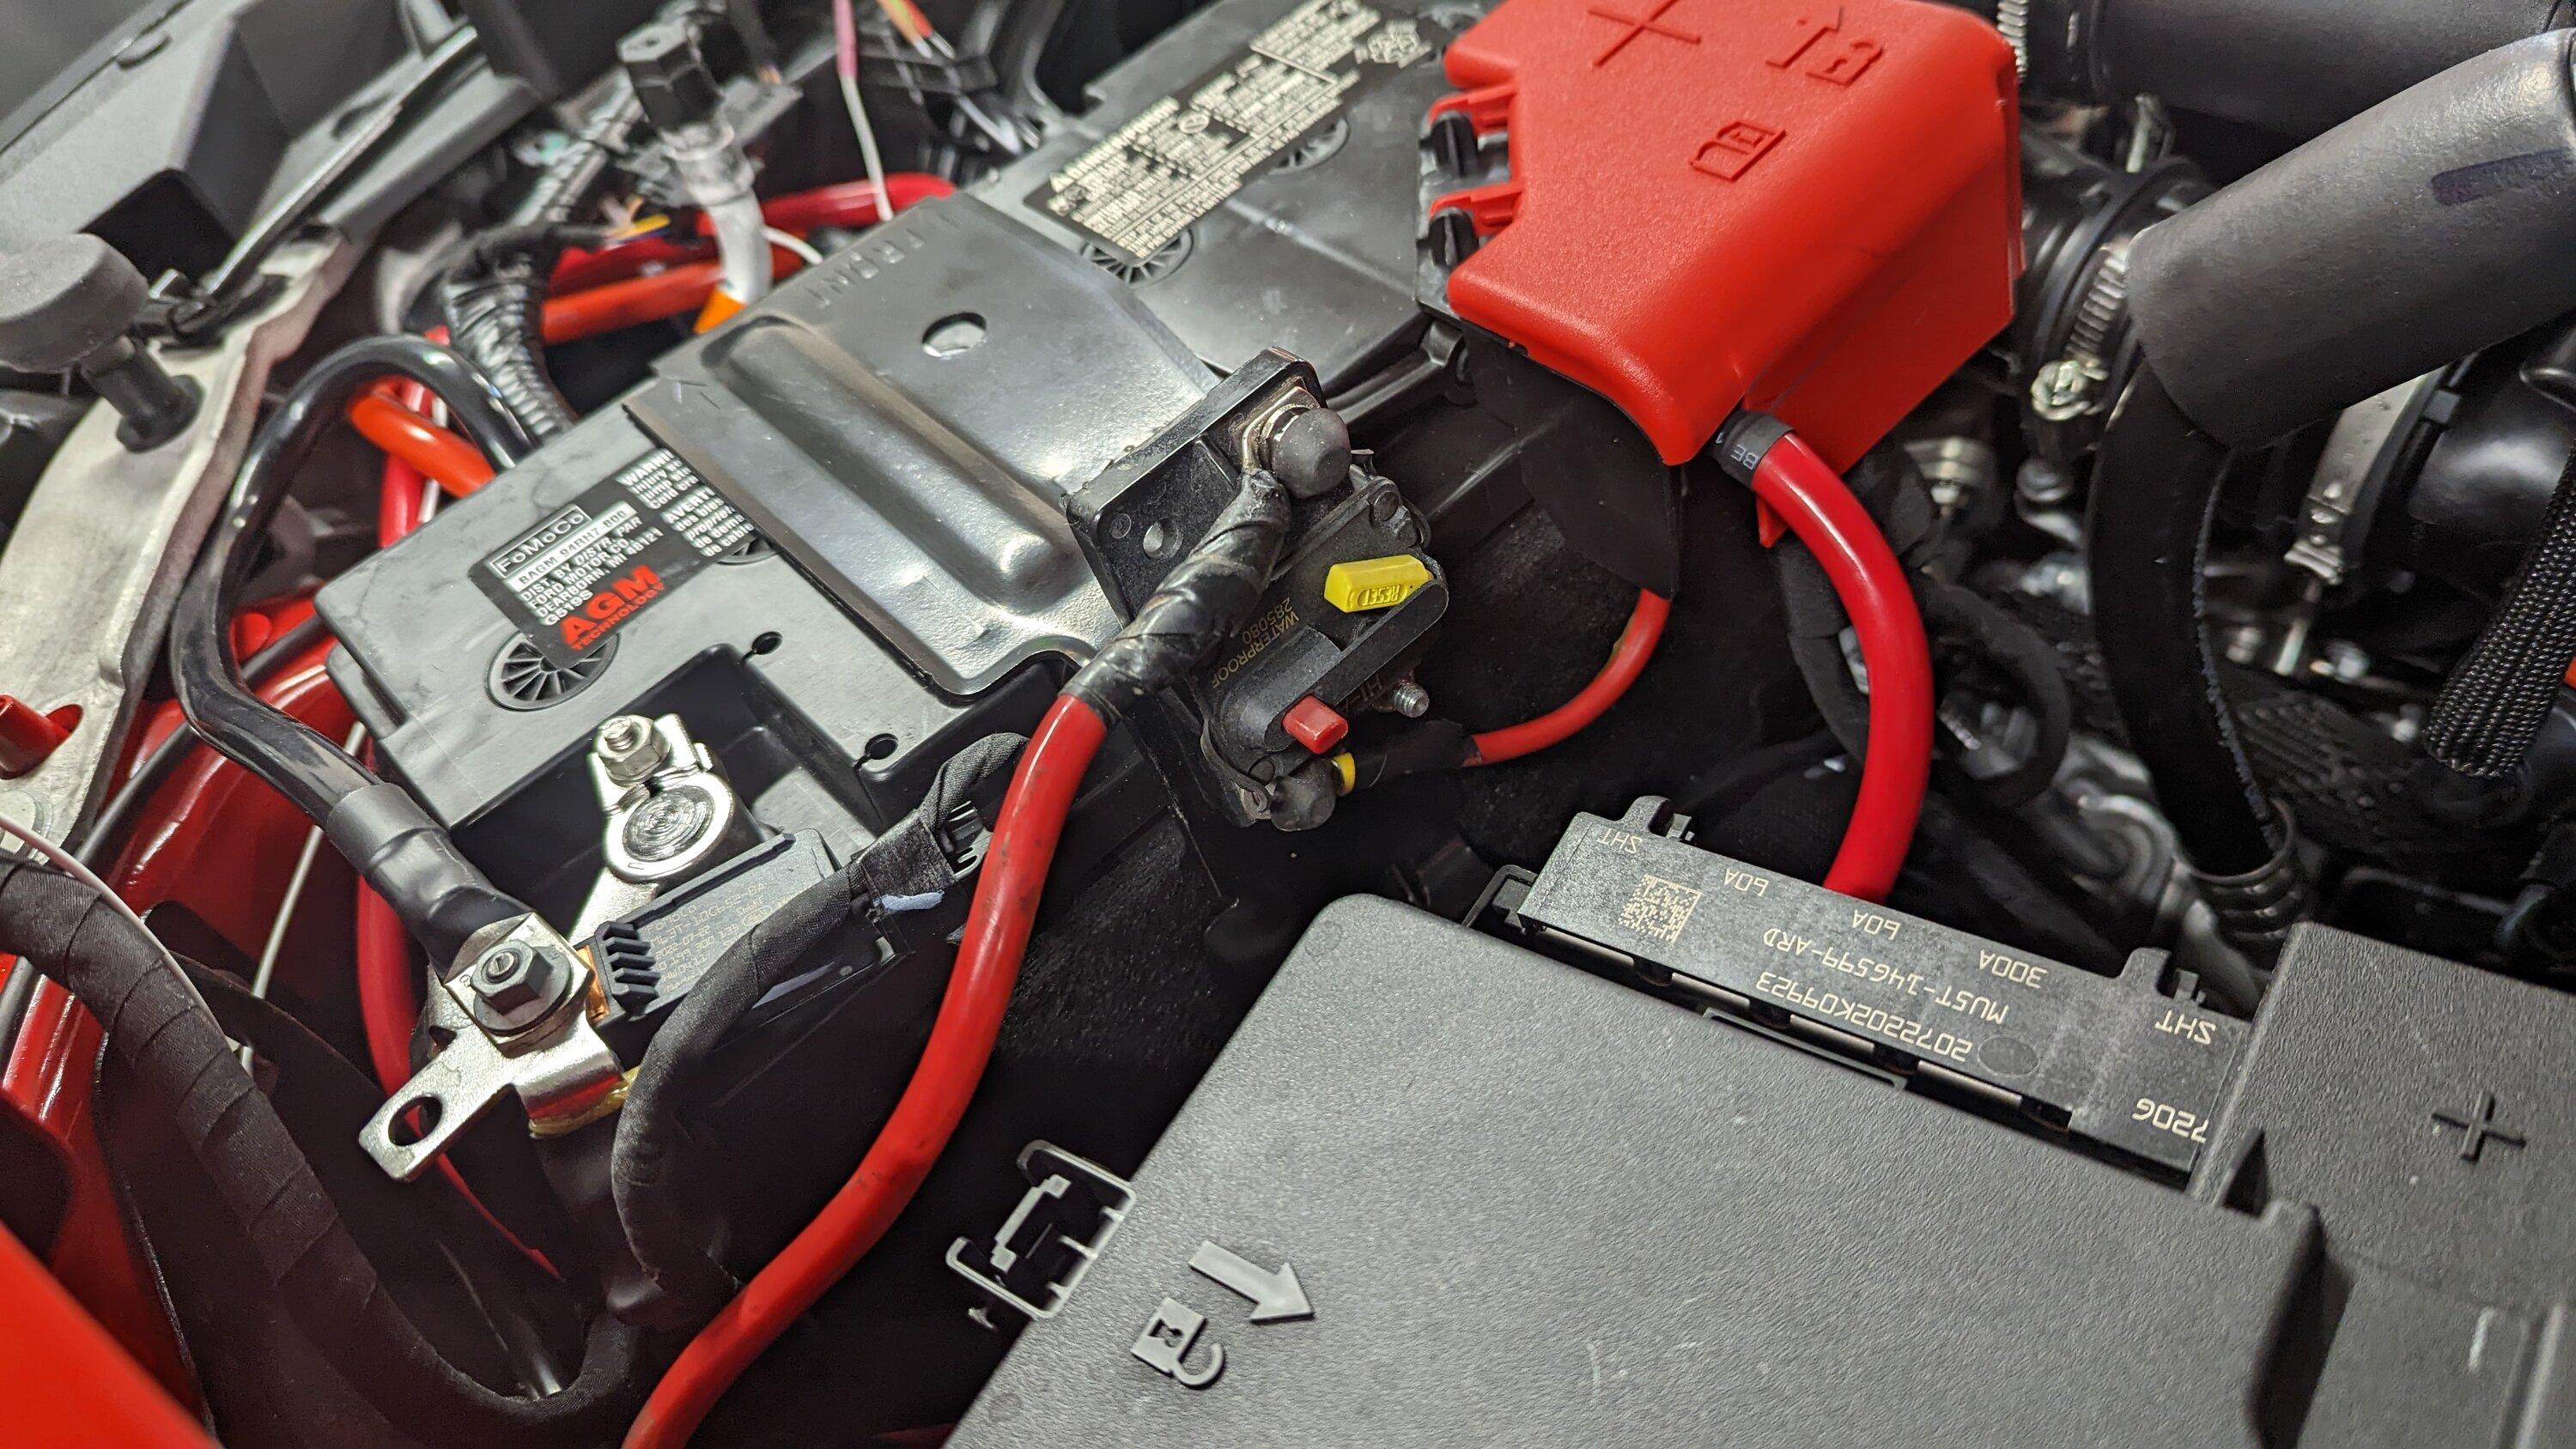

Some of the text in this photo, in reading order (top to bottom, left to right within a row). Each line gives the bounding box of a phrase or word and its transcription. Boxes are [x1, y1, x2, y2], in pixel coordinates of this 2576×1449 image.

[1731, 444, 1759, 470] BE
[495, 512, 585, 573] FoMoCo
[520, 516, 643, 601] DIST. BY DISTR. PAR
[530, 583, 565, 609] FORD
[564, 551, 611, 585] MOTOR
[537, 527, 664, 618] DEARBORN, MI 48121
[1362, 585, 1400, 606] RESET
[560, 565, 660, 645] AGM
[573, 582, 665, 651] TECHNOLOGY
[1242, 597, 1293, 645] 285080
[1212, 611, 1299, 688] WATERPROOF
[1597, 828, 1643, 854] SHT
[1723, 868, 1770, 897] 60A
[1852, 909, 1901, 941] 60A
[1978, 949, 2048, 989] 300A
[1756, 972, 1973, 1063] 2072202K09923
[2154, 1009, 2216, 1046] SHT
